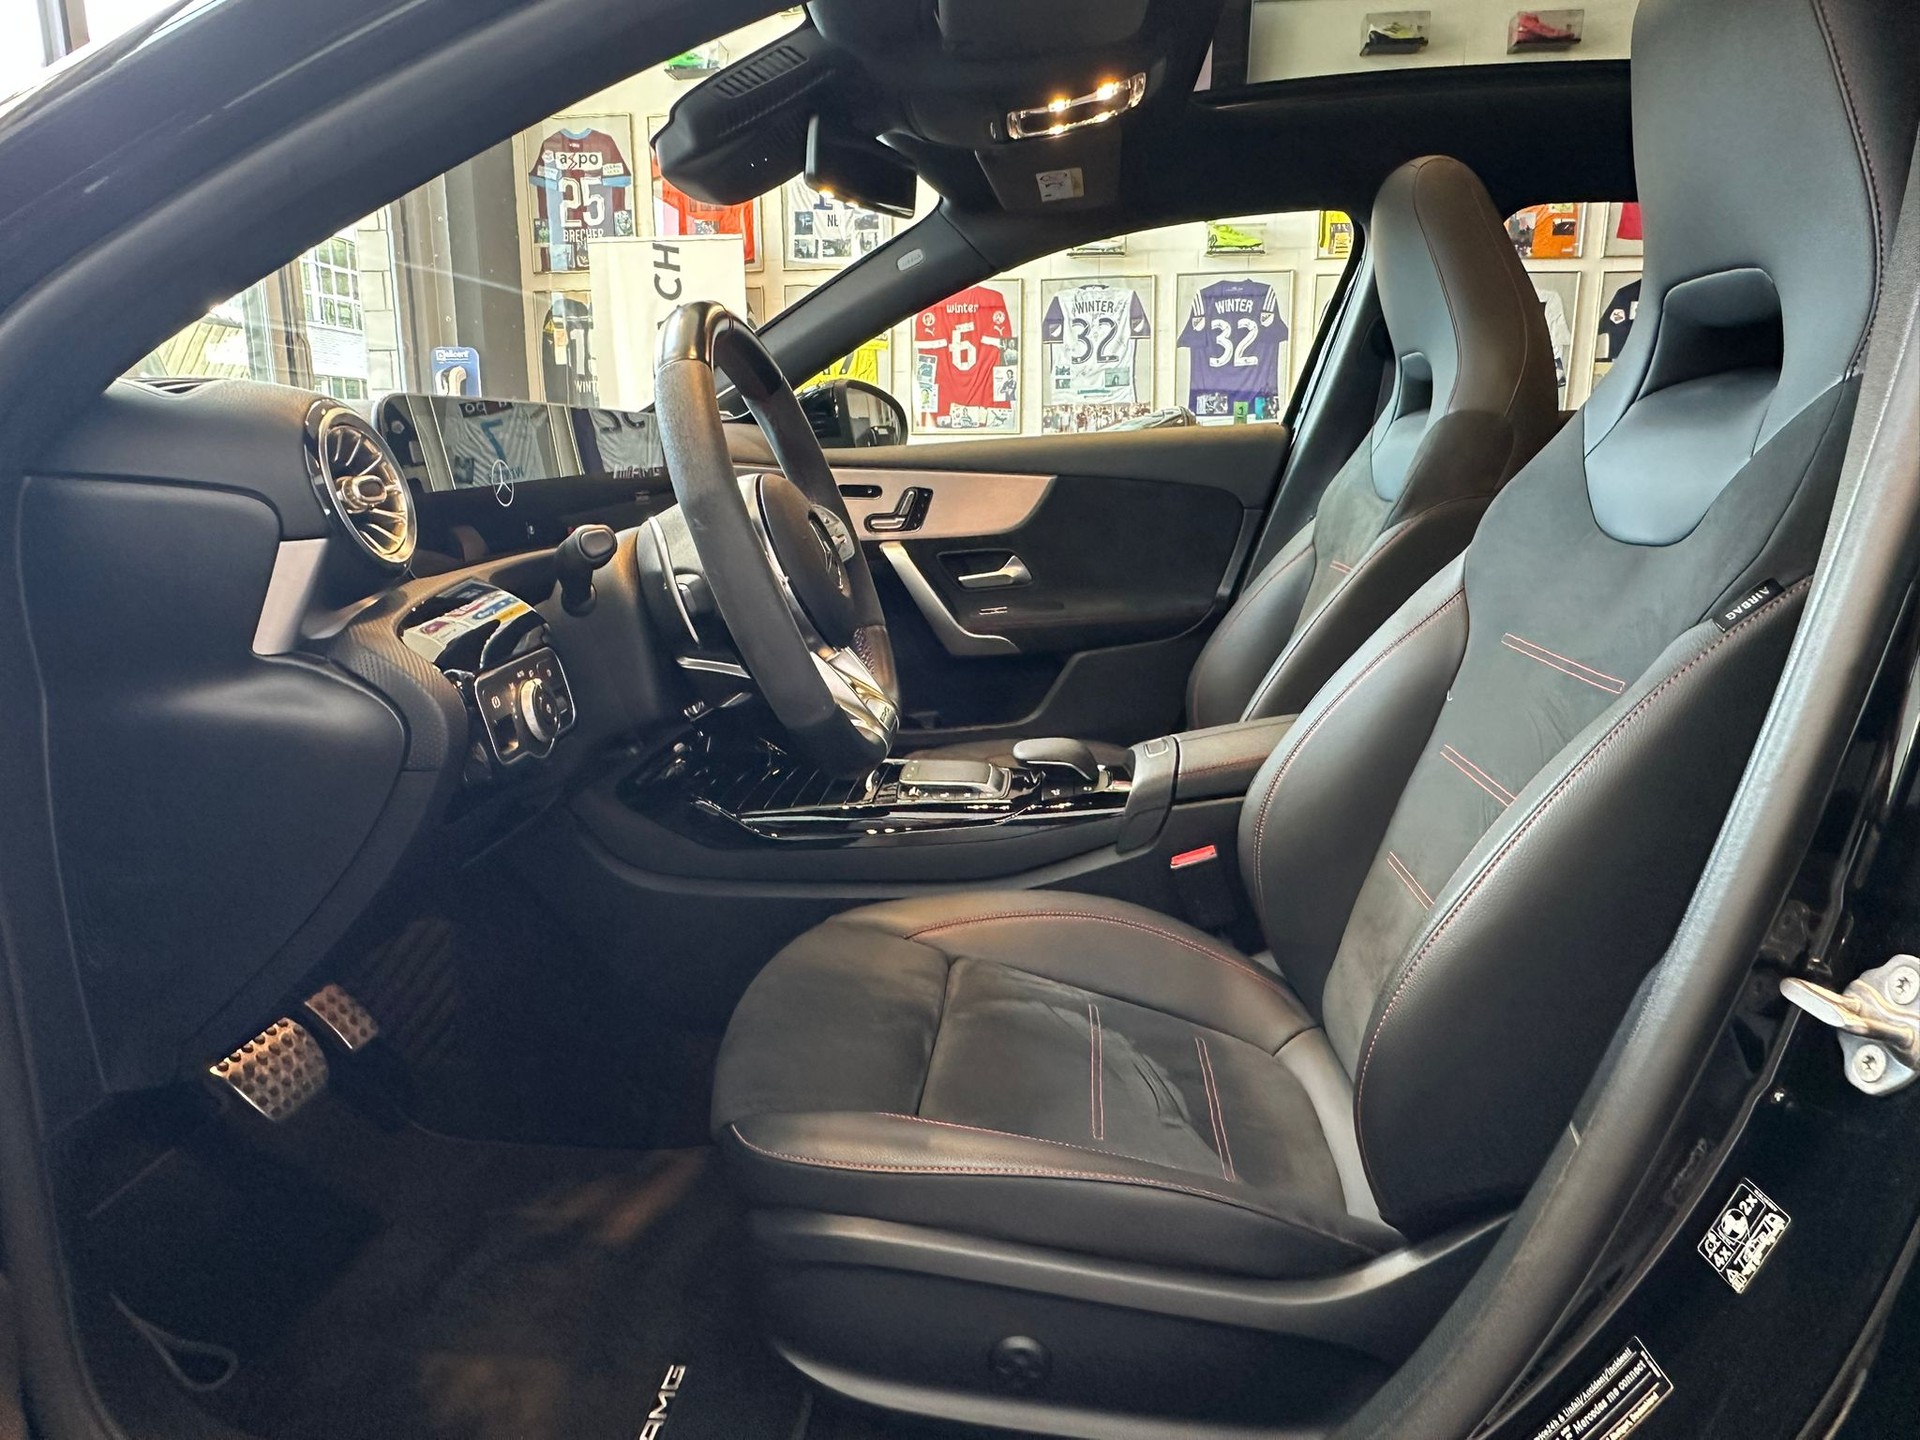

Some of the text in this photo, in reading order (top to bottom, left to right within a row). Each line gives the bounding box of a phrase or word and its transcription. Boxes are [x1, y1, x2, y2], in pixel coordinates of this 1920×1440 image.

[558, 177, 605, 227] 25
[946, 303, 979, 314] winter
[1075, 300, 1114, 314] WINTER
[1215, 298, 1254, 314] WINTER
[948, 321, 977, 372] 6
[1072, 317, 1120, 365] 32
[1209, 318, 1259, 368] 32
[1725, 586, 1770, 620] AIRBAG
[638, 1364, 686, 1440] AMG
